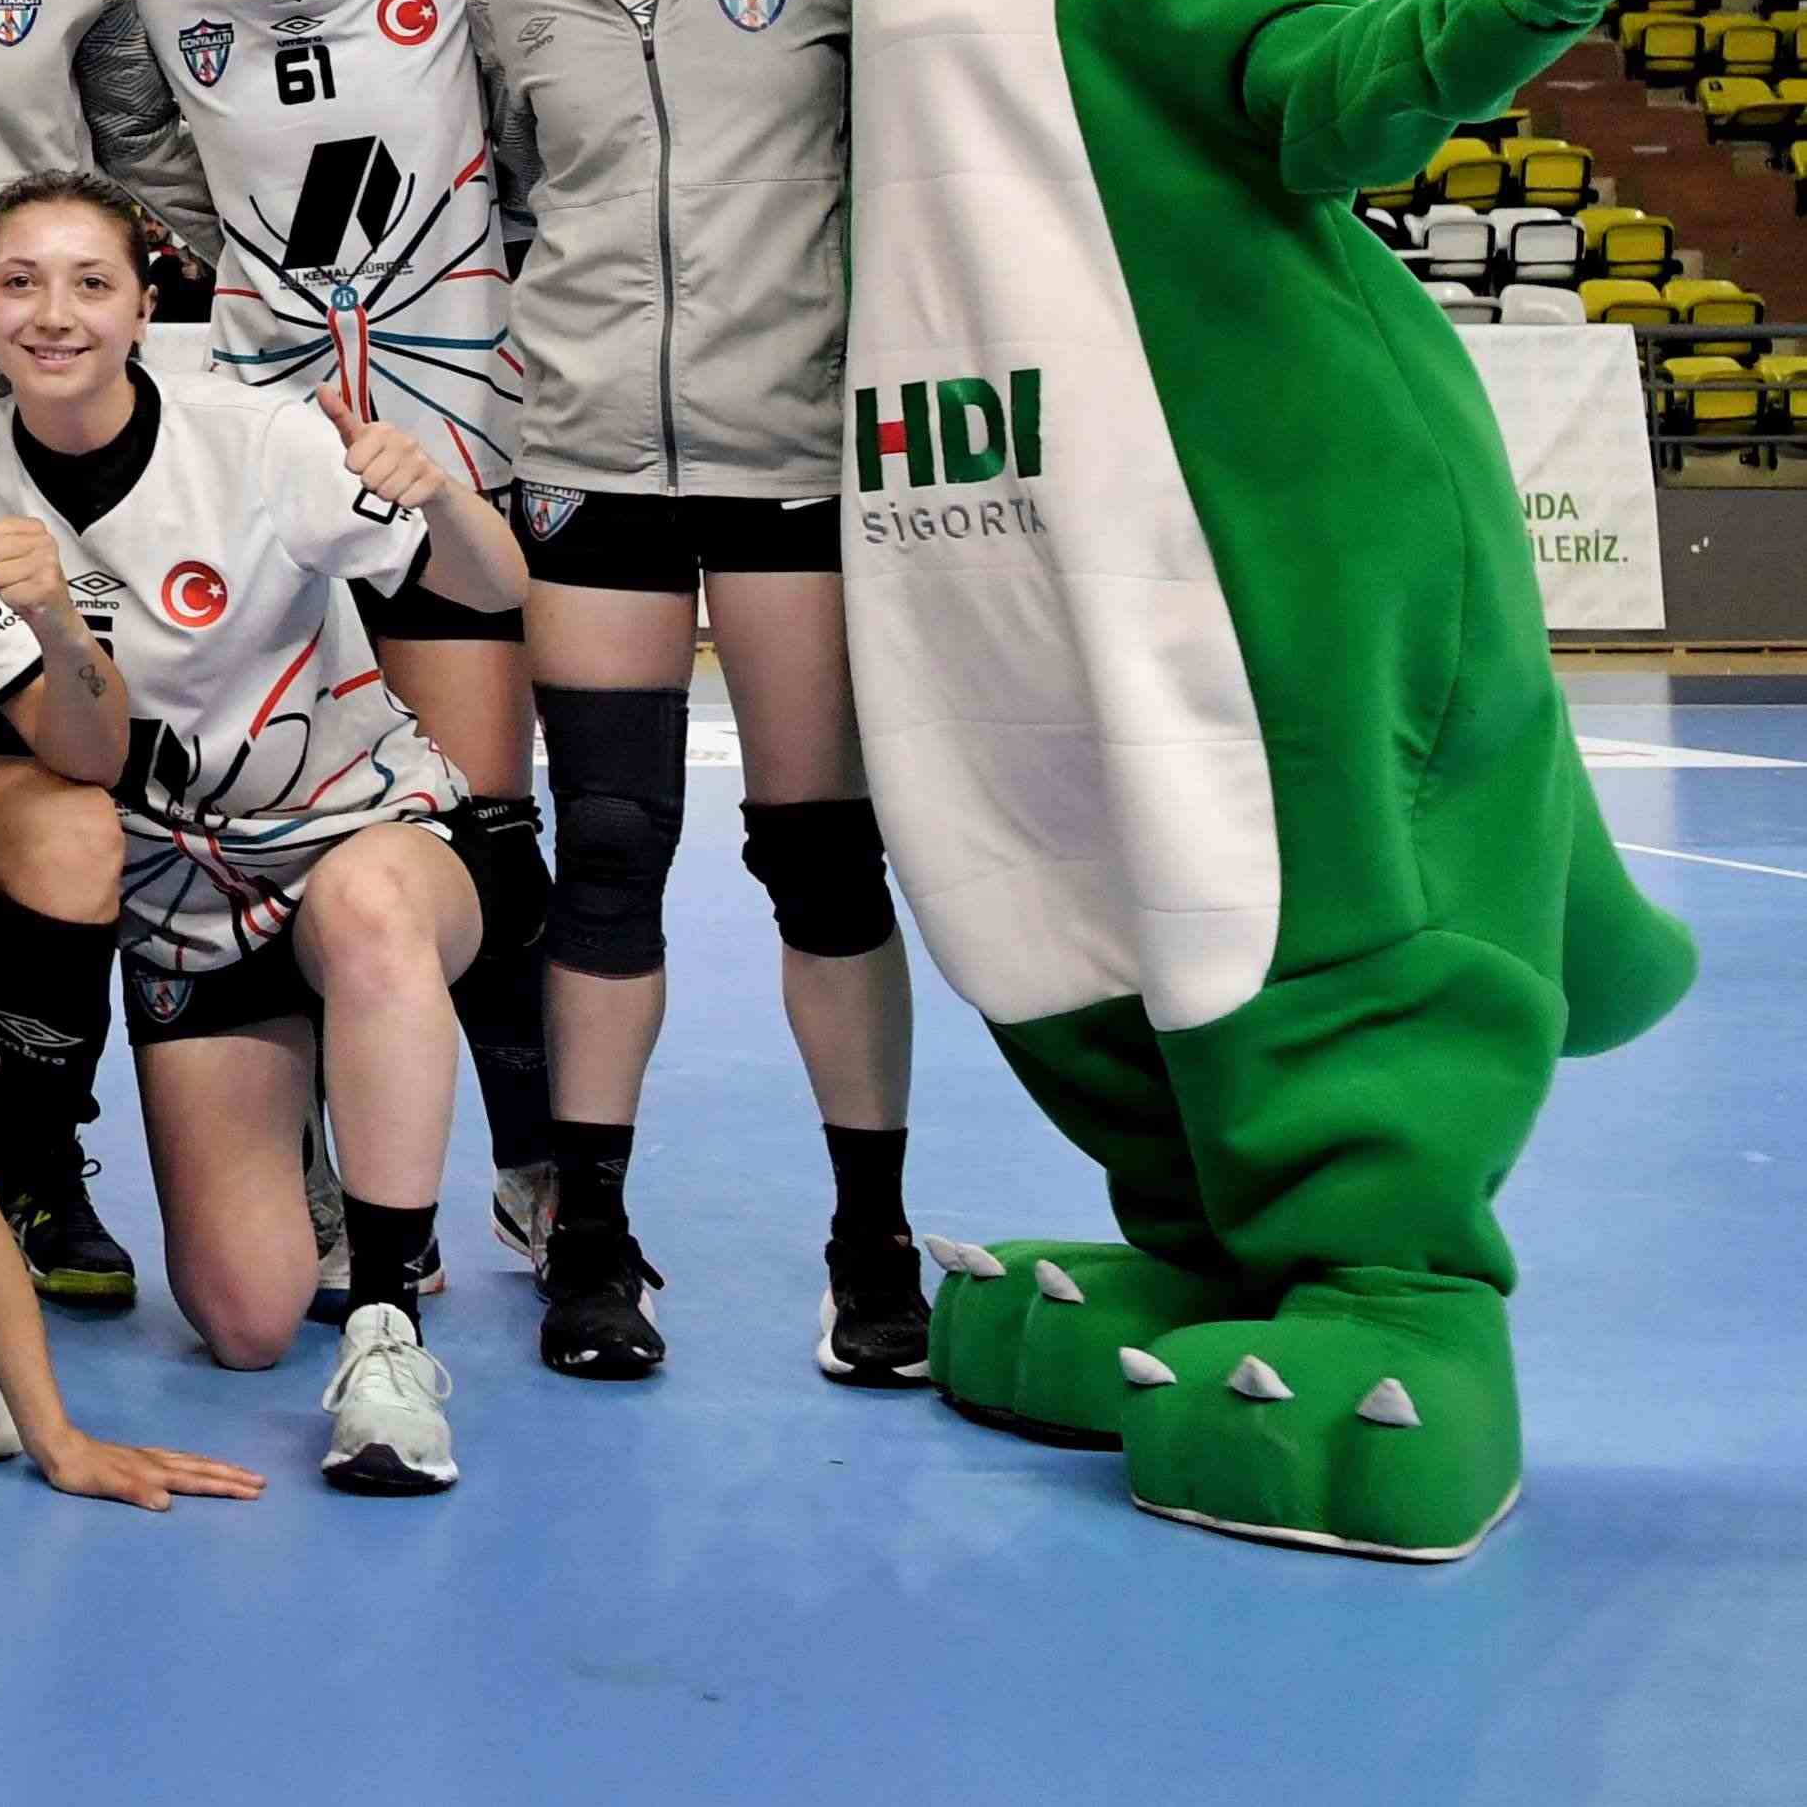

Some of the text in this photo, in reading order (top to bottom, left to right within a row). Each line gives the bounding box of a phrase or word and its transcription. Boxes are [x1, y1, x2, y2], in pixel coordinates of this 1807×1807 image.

[274, 45, 336, 105] 61
[855, 367, 1042, 492] HDI
[862, 498, 1047, 544] SİGORTA
[75, 598, 120, 610] mbro
